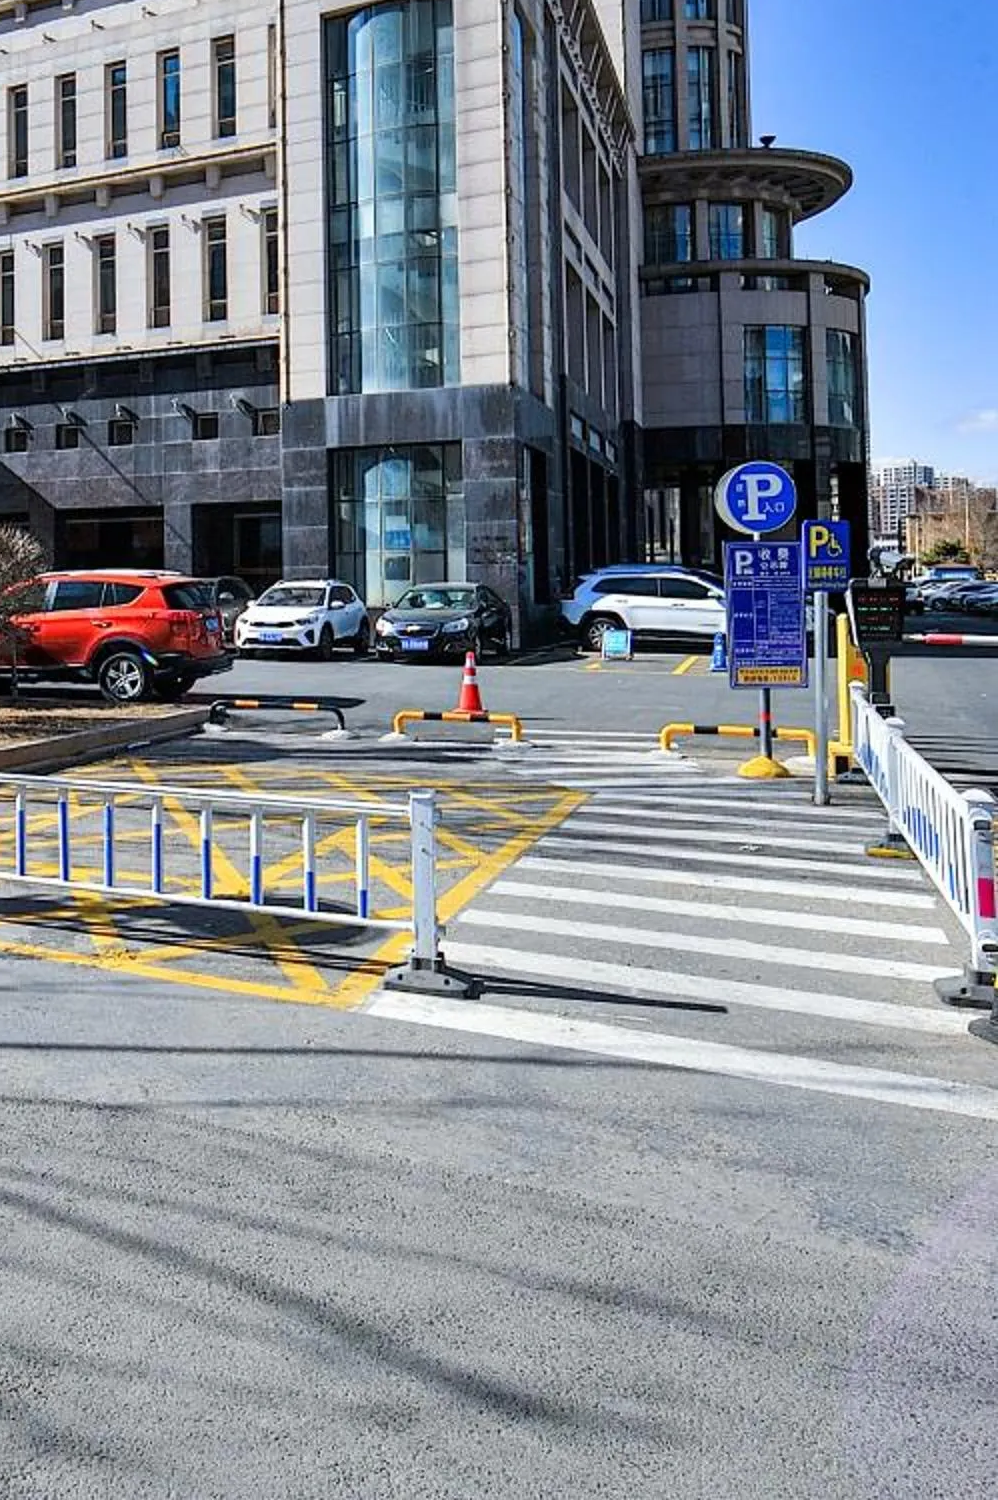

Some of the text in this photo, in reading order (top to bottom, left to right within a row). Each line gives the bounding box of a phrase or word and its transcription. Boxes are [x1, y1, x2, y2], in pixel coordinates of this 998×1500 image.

[740, 473, 783, 520] P
[763, 501, 785, 513] 入口
[810, 525, 829, 558] P
[735, 550, 755, 575] P
